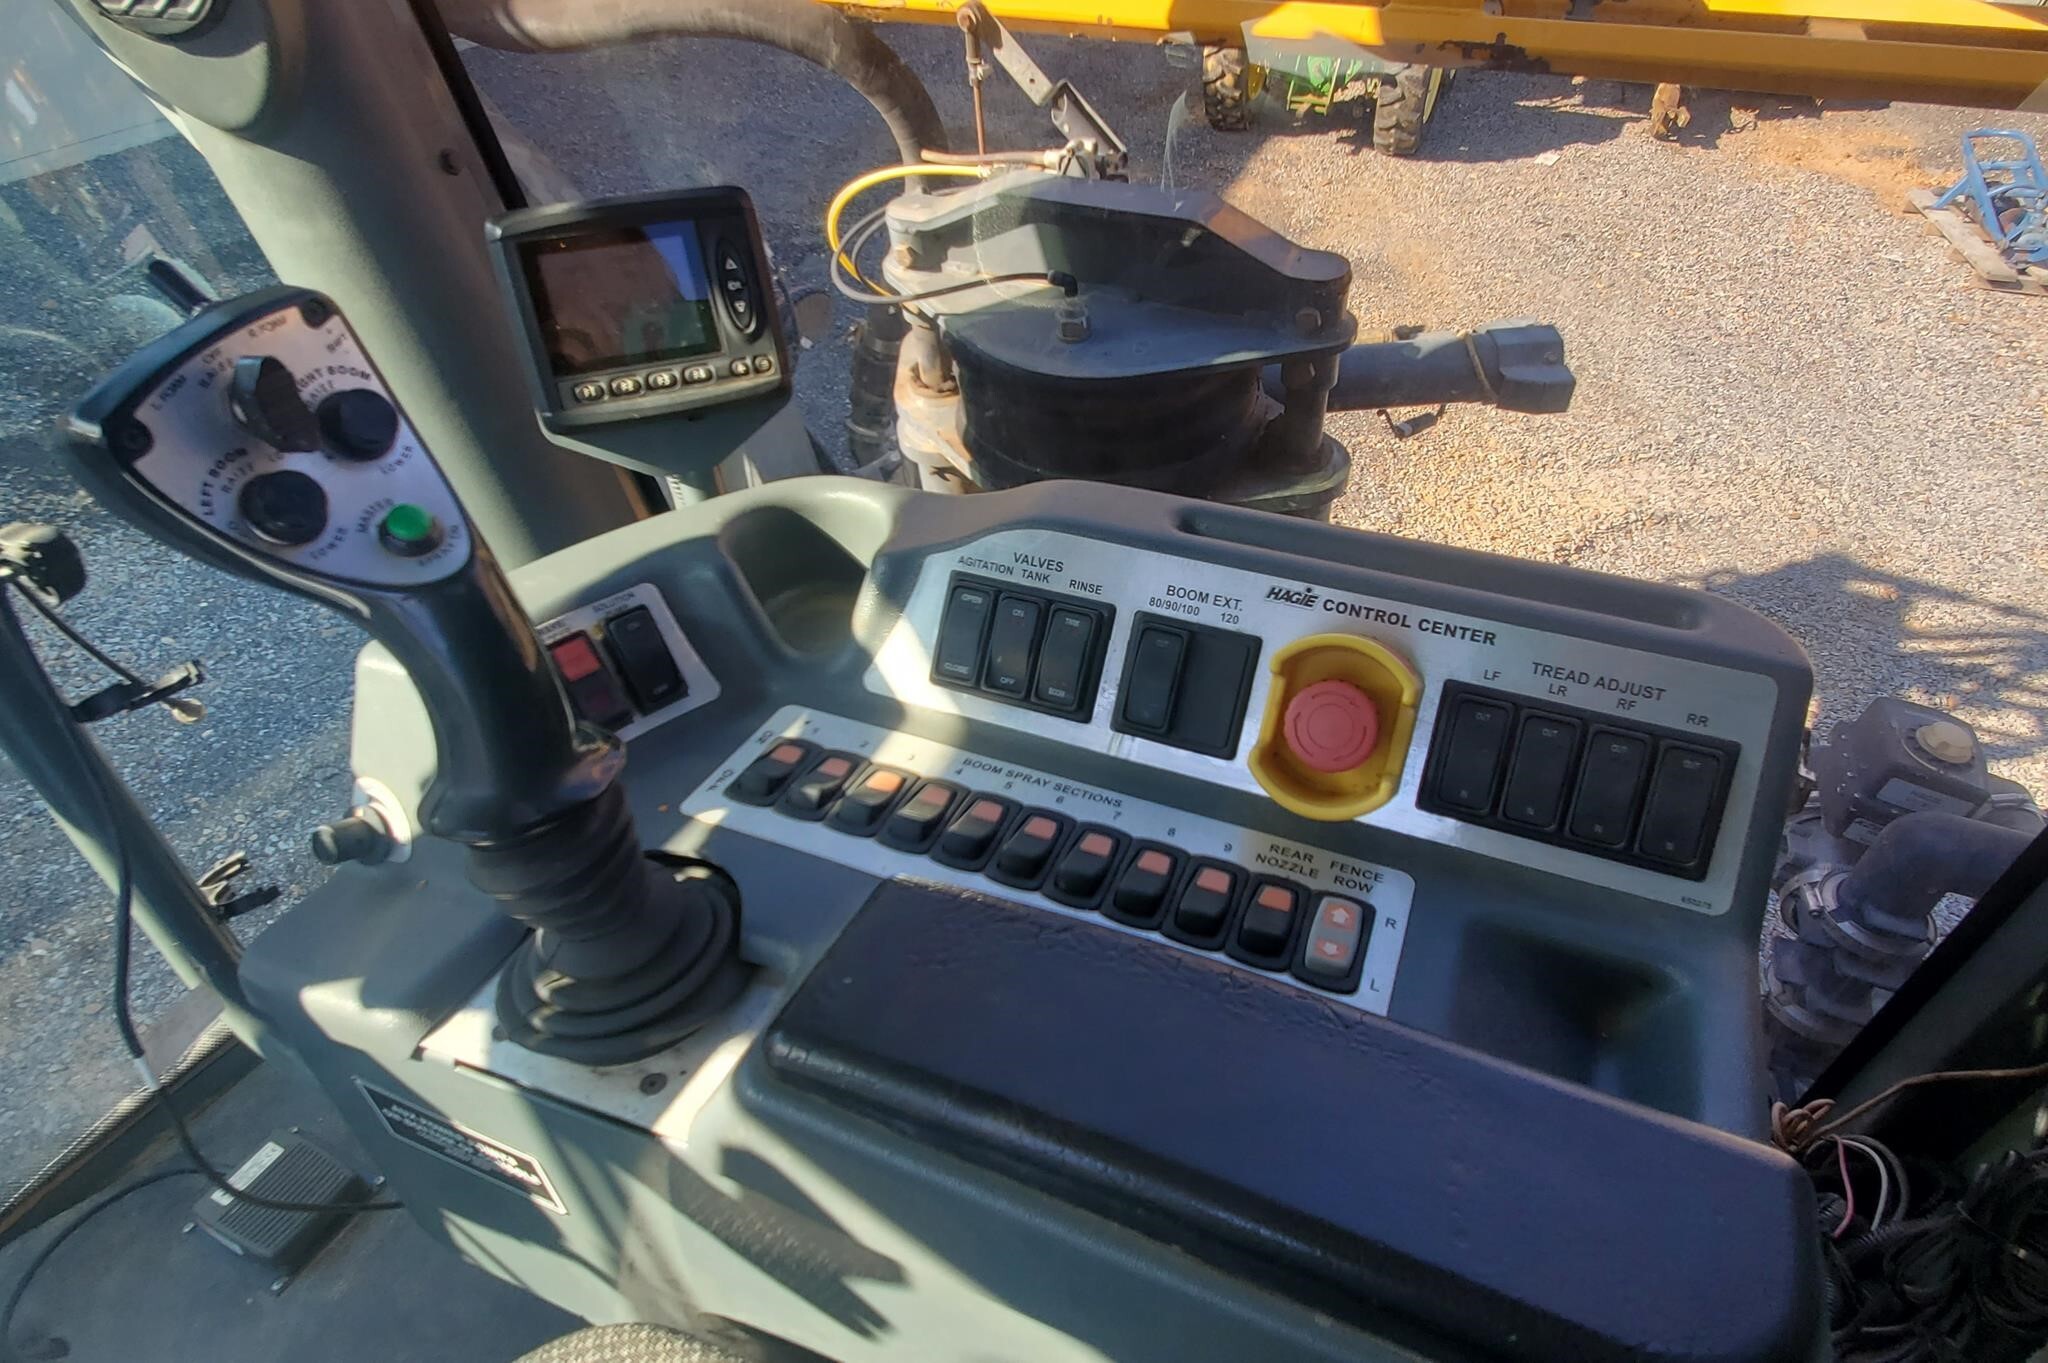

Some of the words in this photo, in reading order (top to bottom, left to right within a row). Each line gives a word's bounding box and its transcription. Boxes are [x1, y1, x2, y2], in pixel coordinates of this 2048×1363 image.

[327, 365, 372, 382] BOOM
[201, 482, 214, 516] LEFT
[208, 448, 248, 478] BOOM
[958, 555, 1014, 576] AGITATION
[1013, 552, 1064, 573] VALVES
[1021, 568, 1051, 584] TANK
[1069, 579, 1104, 596] RINSE
[961, 593, 982, 604] OPEN
[1166, 584, 1210, 602] BOOM
[1213, 594, 1243, 612] EXT.
[1012, 609, 1024, 618] ON
[1148, 597, 1200, 617] 80/90/100
[1220, 612, 1240, 626] 120
[1322, 598, 1412, 629] CONTROL
[1417, 618, 1497, 646] CENTER
[944, 662, 969, 674] CLOSE
[1484, 669, 1501, 683] LF
[1000, 676, 1015, 685] OFF
[1532, 661, 1591, 687] TREAD
[1593, 675, 1667, 702] ADJUST
[1548, 683, 1568, 697] LR
[1616, 698, 1637, 711] RF
[1686, 713, 1710, 728] RR
[755, 729, 773, 745] ON
[705, 769, 735, 793] OFF
[962, 757, 1003, 775] BOOM
[1005, 767, 1051, 788] SPRAY
[1052, 782, 1123, 808] SECTIONS
[1167, 828, 1176, 837] 8
[1224, 843, 1233, 852] 9
[1269, 843, 1315, 865] REAR
[1255, 853, 1320, 880] NOZZLE
[1329, 860, 1385, 883] FENCE
[1333, 875, 1376, 894] ROW
[1385, 917, 1398, 930] R
[1370, 979, 1381, 992] L
